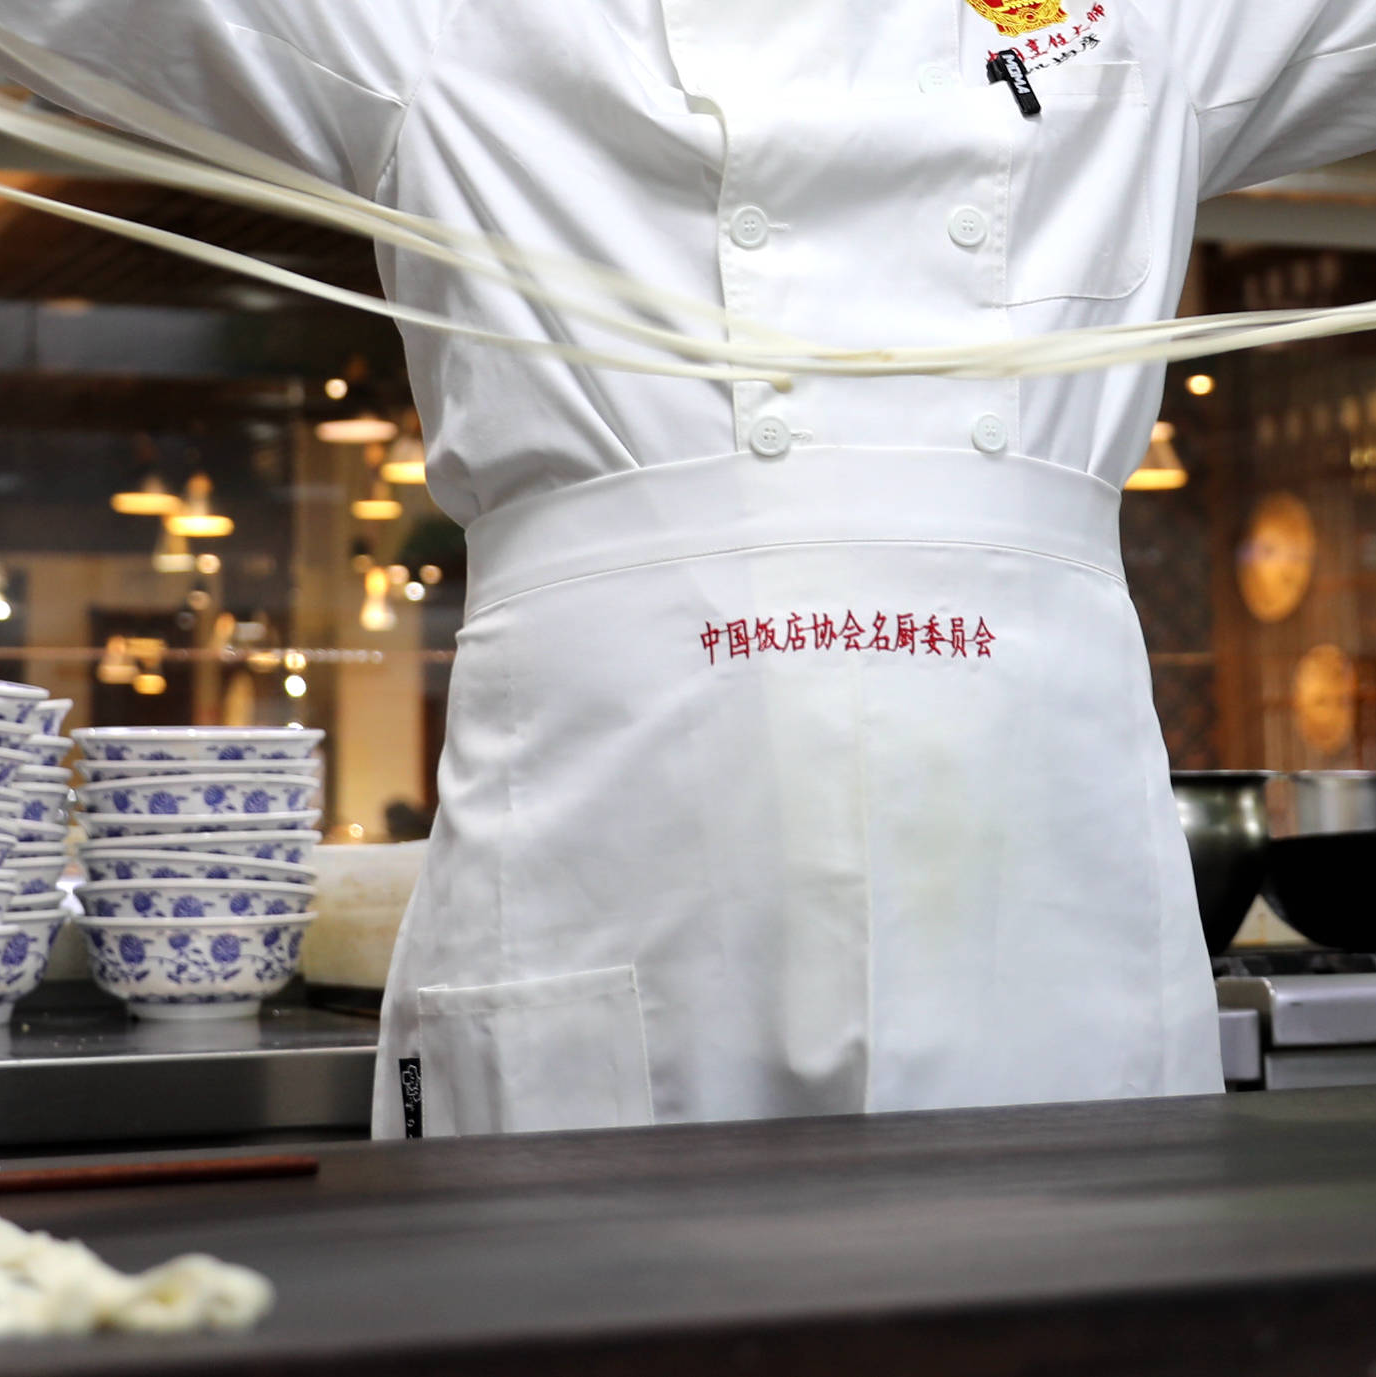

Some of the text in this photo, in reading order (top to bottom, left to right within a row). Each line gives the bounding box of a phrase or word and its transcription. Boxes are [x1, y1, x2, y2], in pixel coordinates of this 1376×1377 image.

[700, 609, 997, 666] 中国饭店协会名厨委员会
